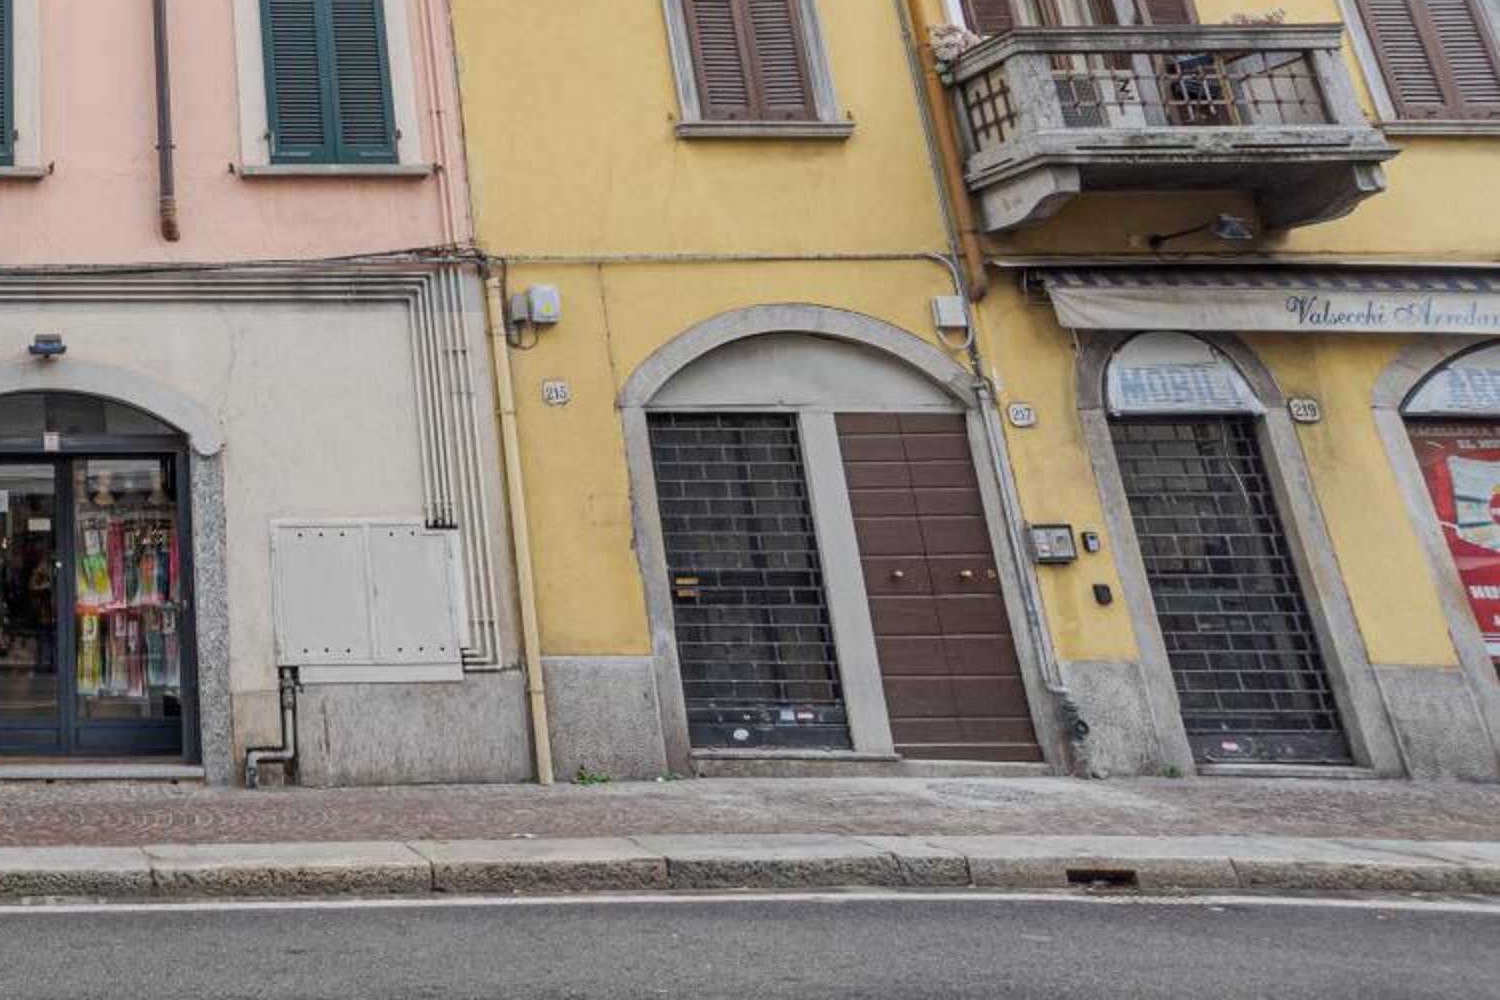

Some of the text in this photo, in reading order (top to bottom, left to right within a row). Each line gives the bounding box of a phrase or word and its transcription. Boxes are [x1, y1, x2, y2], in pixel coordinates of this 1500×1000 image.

[1285, 296, 1385, 325] Valsecchi
[545, 385, 567, 400] 215
[1012, 407, 1031, 420] 217
[1293, 402, 1316, 417] 219
